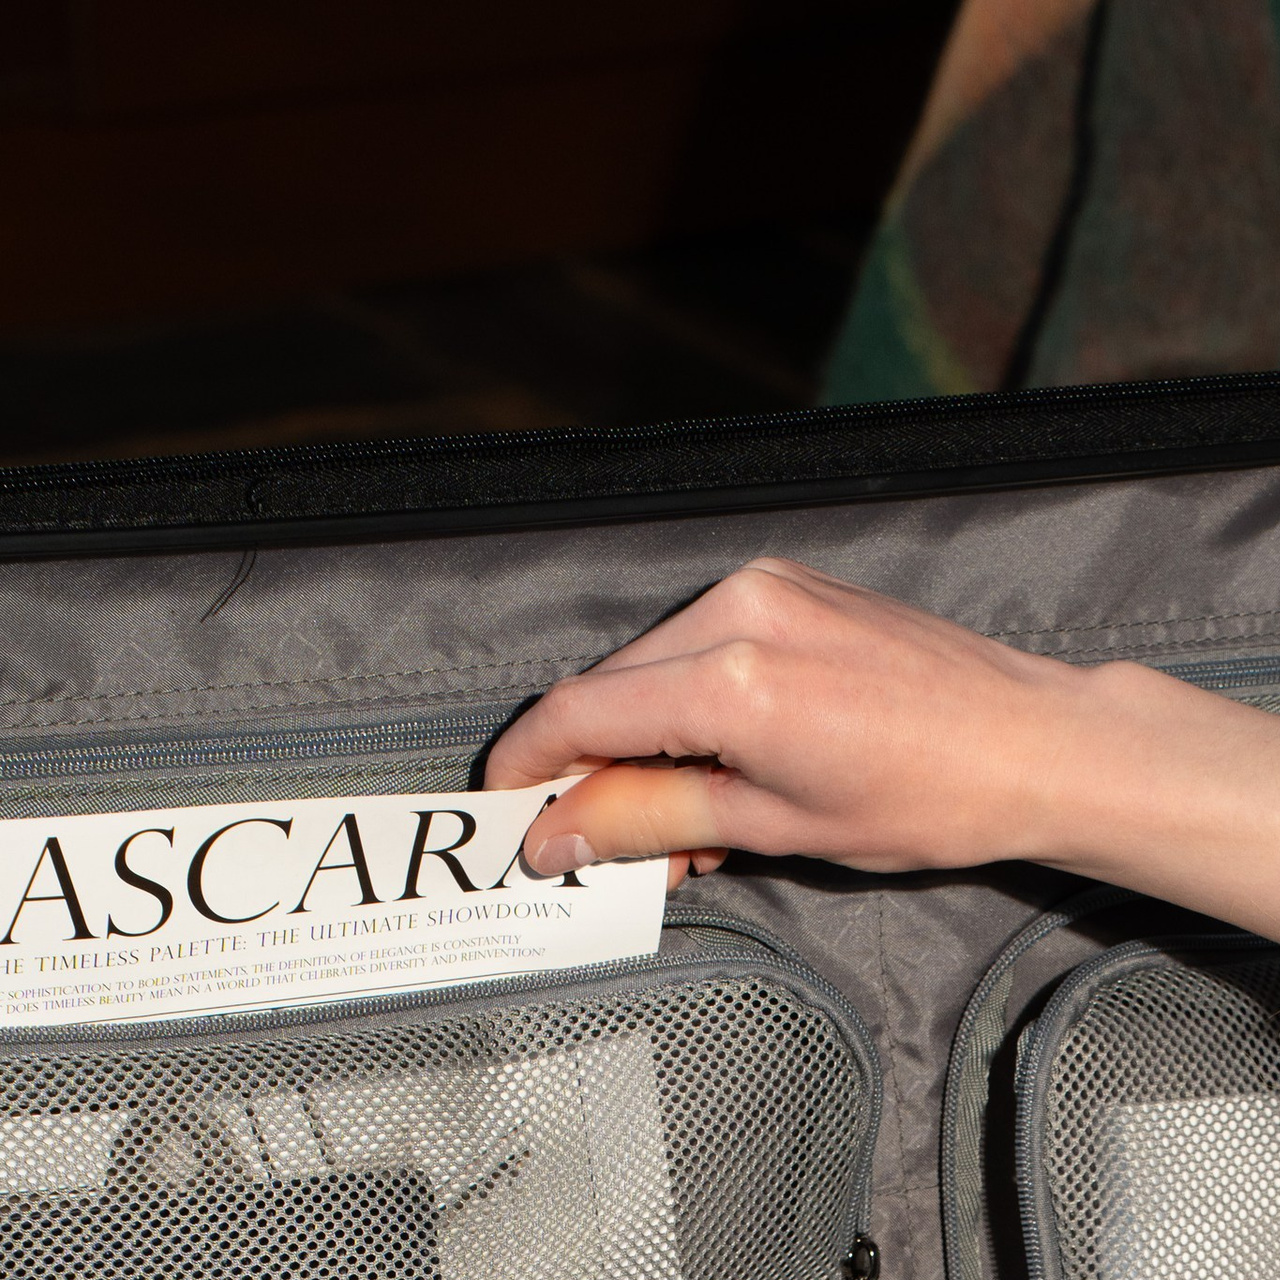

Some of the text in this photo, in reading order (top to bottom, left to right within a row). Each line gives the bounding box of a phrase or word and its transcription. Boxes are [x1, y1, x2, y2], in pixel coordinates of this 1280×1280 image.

[8, 982, 112, 1001] SOPHISTICATION
[115, 980, 134, 991] TO
[138, 976, 170, 989] BOLD
[252, 962, 275, 974] THE
[278, 953, 347, 971] DEFINITION
[350, 951, 367, 962] OF
[369, 943, 428, 959] ELEGANCE
[431, 942, 441, 952] IS
[443, 934, 522, 951] CONSTANTLY
[34, 949, 140, 972] TIMELESS
[150, 935, 247, 962] PALETTE:
[256, 927, 300, 947] THE
[310, 912, 419, 941] ULTIMATE
[426, 902, 573, 927] SHOWDOWN
[6, 947, 546, 1015] DOES TIMELESS BEAUTY MEAN IN A WORLD THAT CELEBRATES DIVERSITY AND REINVENTION?
